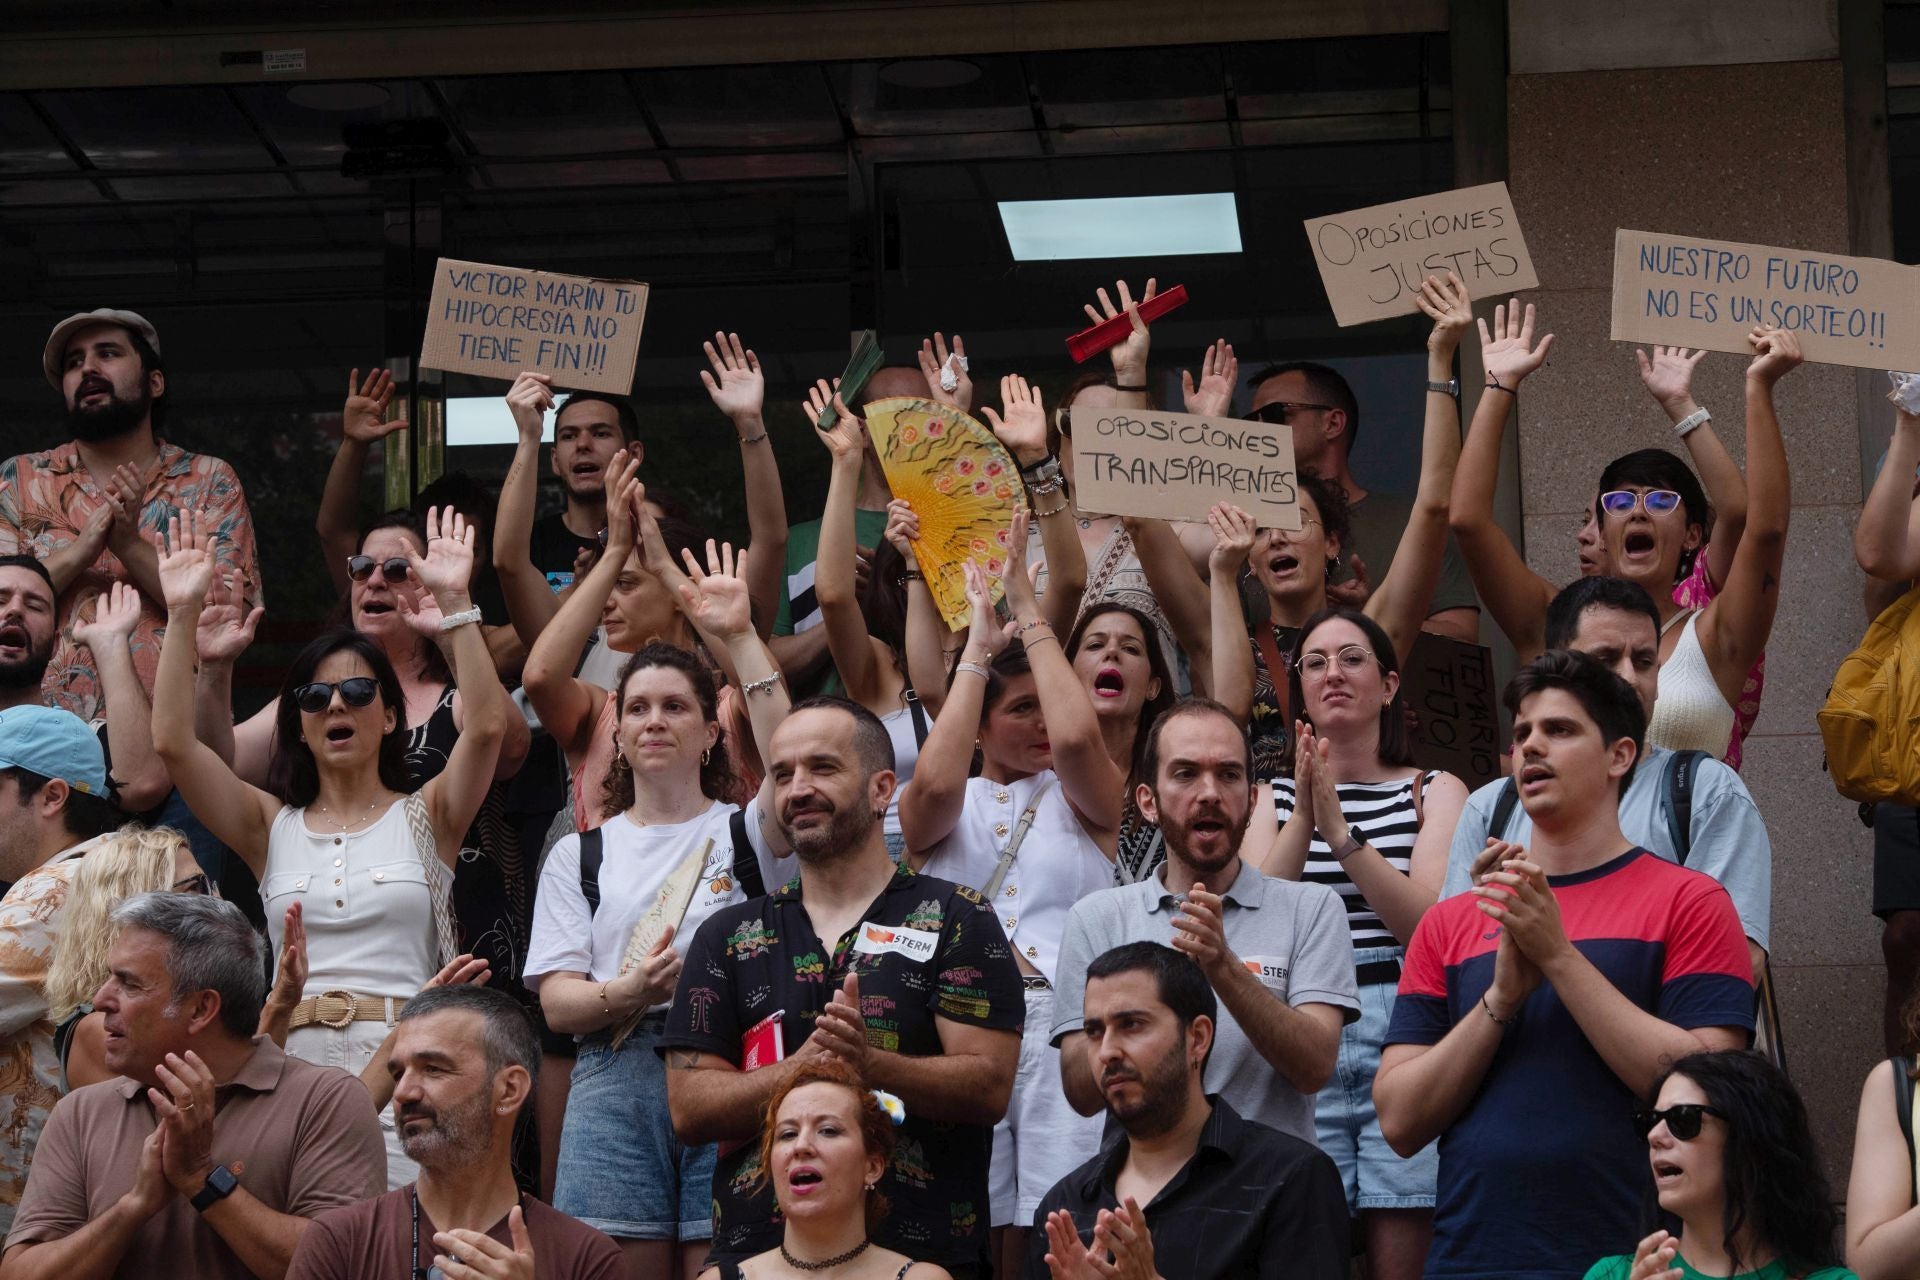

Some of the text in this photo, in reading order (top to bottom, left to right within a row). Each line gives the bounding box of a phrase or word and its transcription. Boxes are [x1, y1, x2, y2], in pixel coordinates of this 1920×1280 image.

[1368, 238, 1518, 304] JUSTAS
[1640, 244, 1859, 296] NUESTRO FUTURO
[449, 269, 527, 299] VICTOR
[615, 288, 637, 315] TU
[444, 298, 617, 340] HIPOCRESÍA NO
[1646, 289, 1886, 348] NO ES UN SORTEO!!
[458, 333, 607, 375] TIENE FIN!!!
[1080, 452, 1296, 504] TRANSPARENTES
[1459, 648, 1494, 776] TEMARIO
[1677, 762, 1687, 788] Targus
[793, 952, 819, 968] BOB
[894, 935, 932, 953] STERM
[858, 999, 896, 1009] EDEMPTION
[862, 1006, 884, 1017] SONG
[867, 1018, 899, 1031] MARLEY
